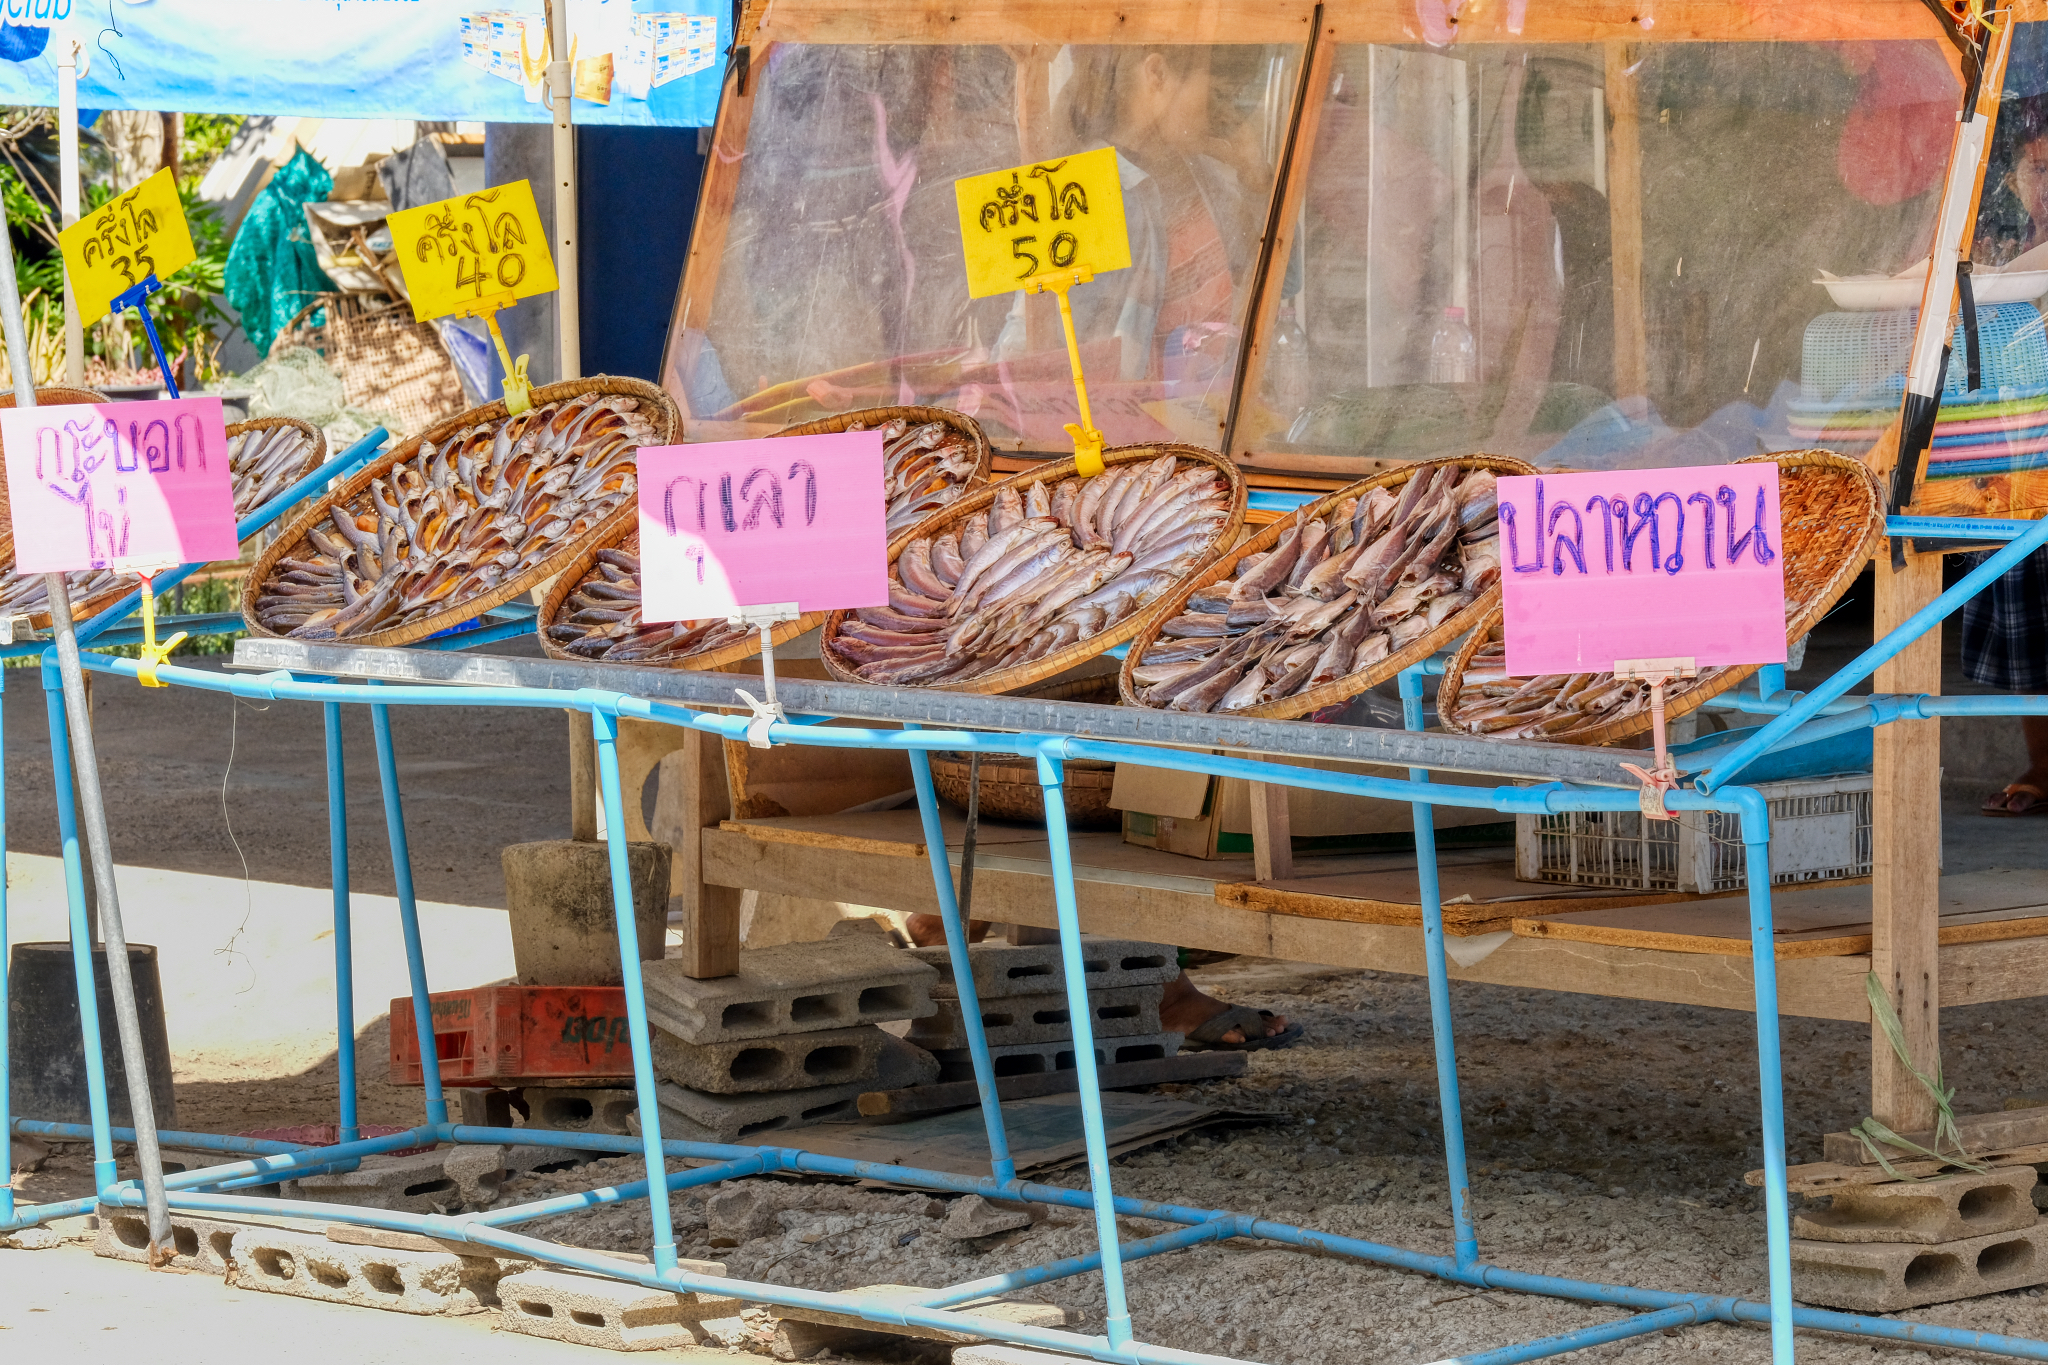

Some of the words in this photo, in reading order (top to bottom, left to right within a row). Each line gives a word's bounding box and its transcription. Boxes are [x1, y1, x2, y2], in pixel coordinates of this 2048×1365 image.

[111, 244, 155, 290] 35
[456, 253, 526, 297] 40
[1011, 230, 1078, 281] 50
[36, 413, 206, 482] กระบอก
[1498, 477, 1775, 576] ปลาหวาน
